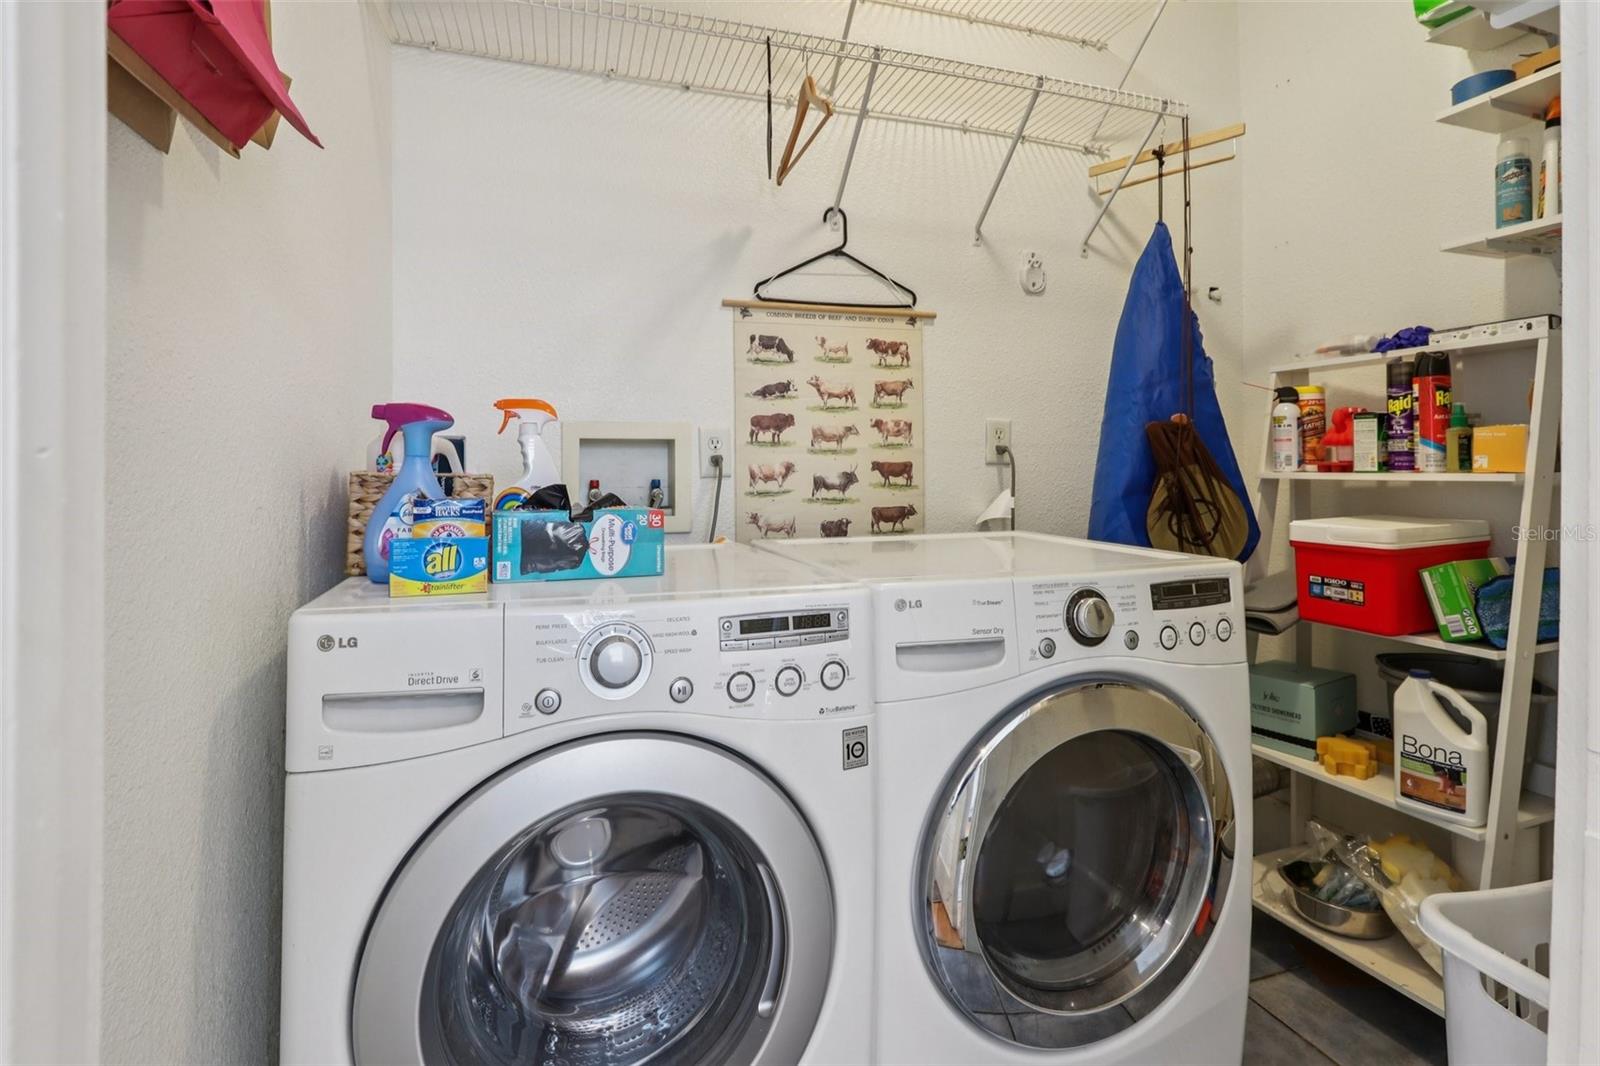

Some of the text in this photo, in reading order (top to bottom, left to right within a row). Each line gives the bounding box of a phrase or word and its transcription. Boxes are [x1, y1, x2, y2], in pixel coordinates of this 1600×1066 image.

[795, 312, 816, 320] BREEDS
[828, 313, 842, 321] BEEF
[1387, 394, 1412, 413] Raid
[639, 514, 647, 526] 20
[651, 513, 661, 527] 30
[607, 518, 615, 572] Multi-Purpose
[426, 545, 458, 575] all
[908, 599, 922, 609] LG
[993, 627, 1004, 635] Dry
[338, 636, 358, 649] LG
[408, 674, 459, 687] Direct Drive
[846, 741, 865, 761] 10
[1402, 734, 1464, 766] Bona
